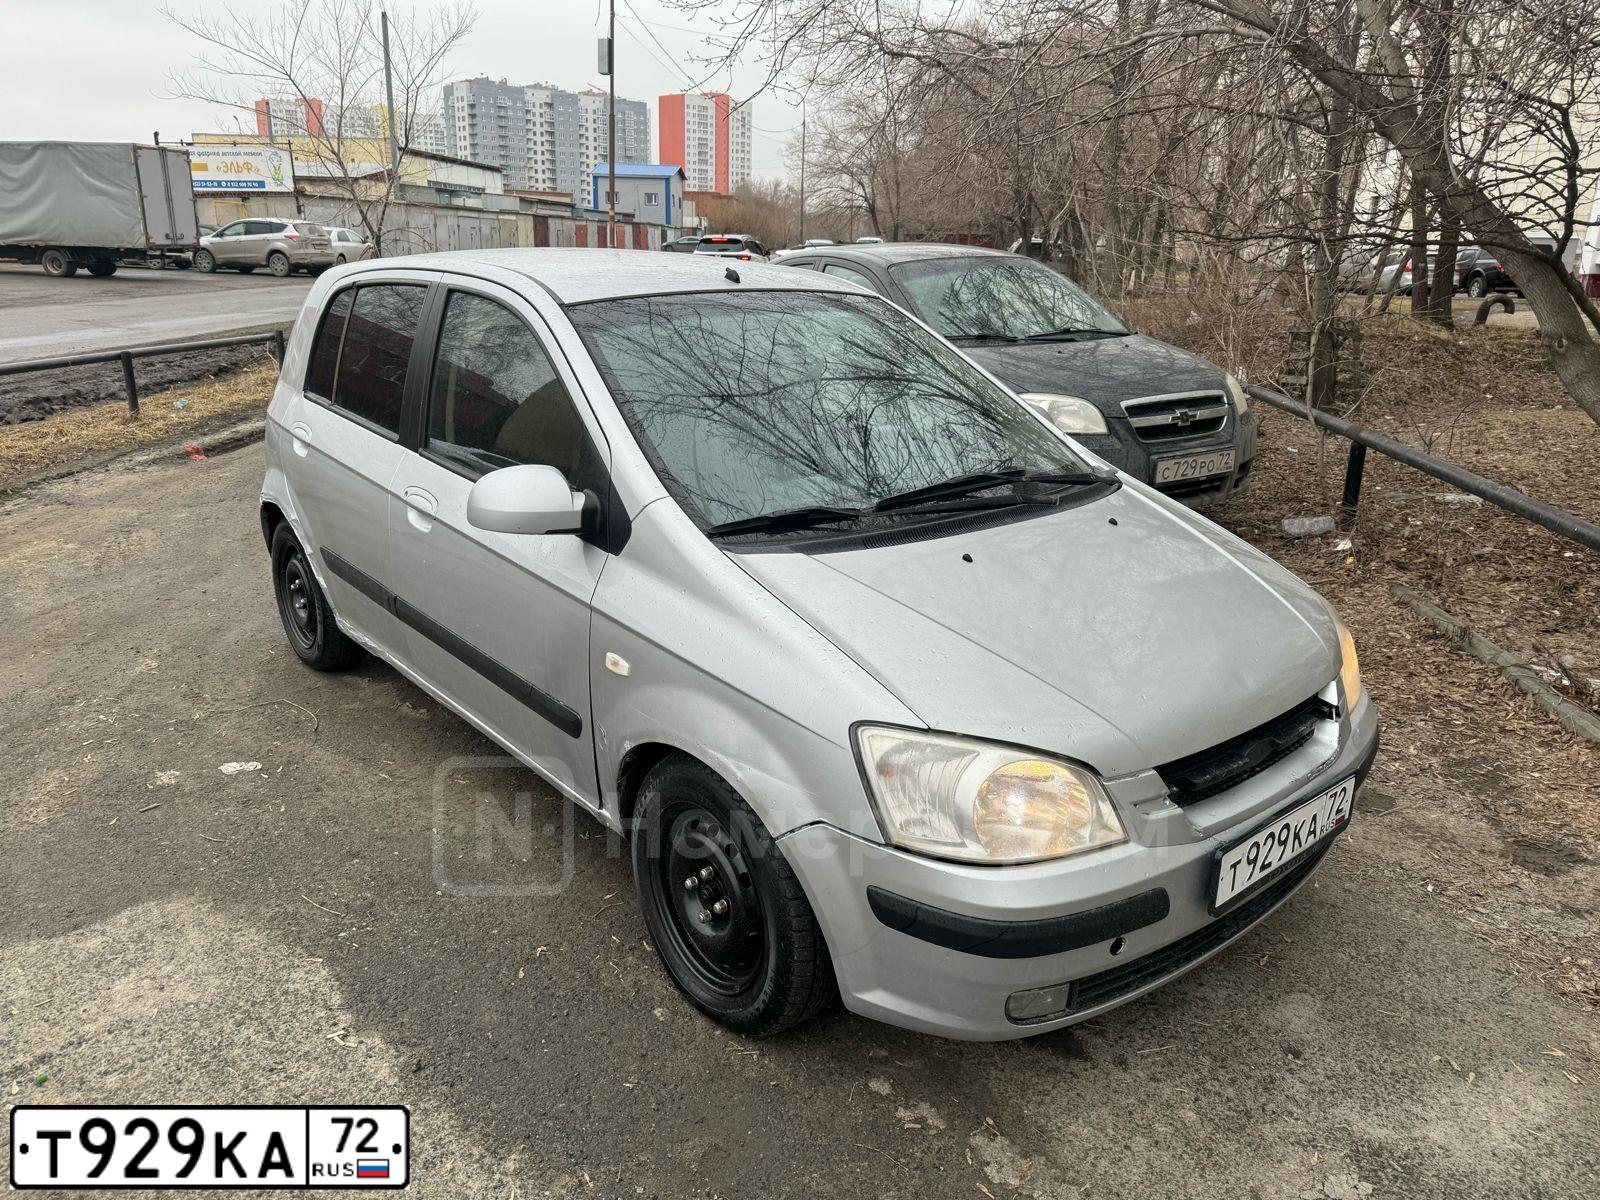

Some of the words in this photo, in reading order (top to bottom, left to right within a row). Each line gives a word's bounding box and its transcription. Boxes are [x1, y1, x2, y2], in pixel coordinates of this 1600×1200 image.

[1161, 458, 1215, 480] С729РО
[1218, 452, 1231, 466] 72
[1229, 812, 1318, 892] Т929КА
[1327, 786, 1347, 820] 72
[1319, 817, 1336, 835] RUS
